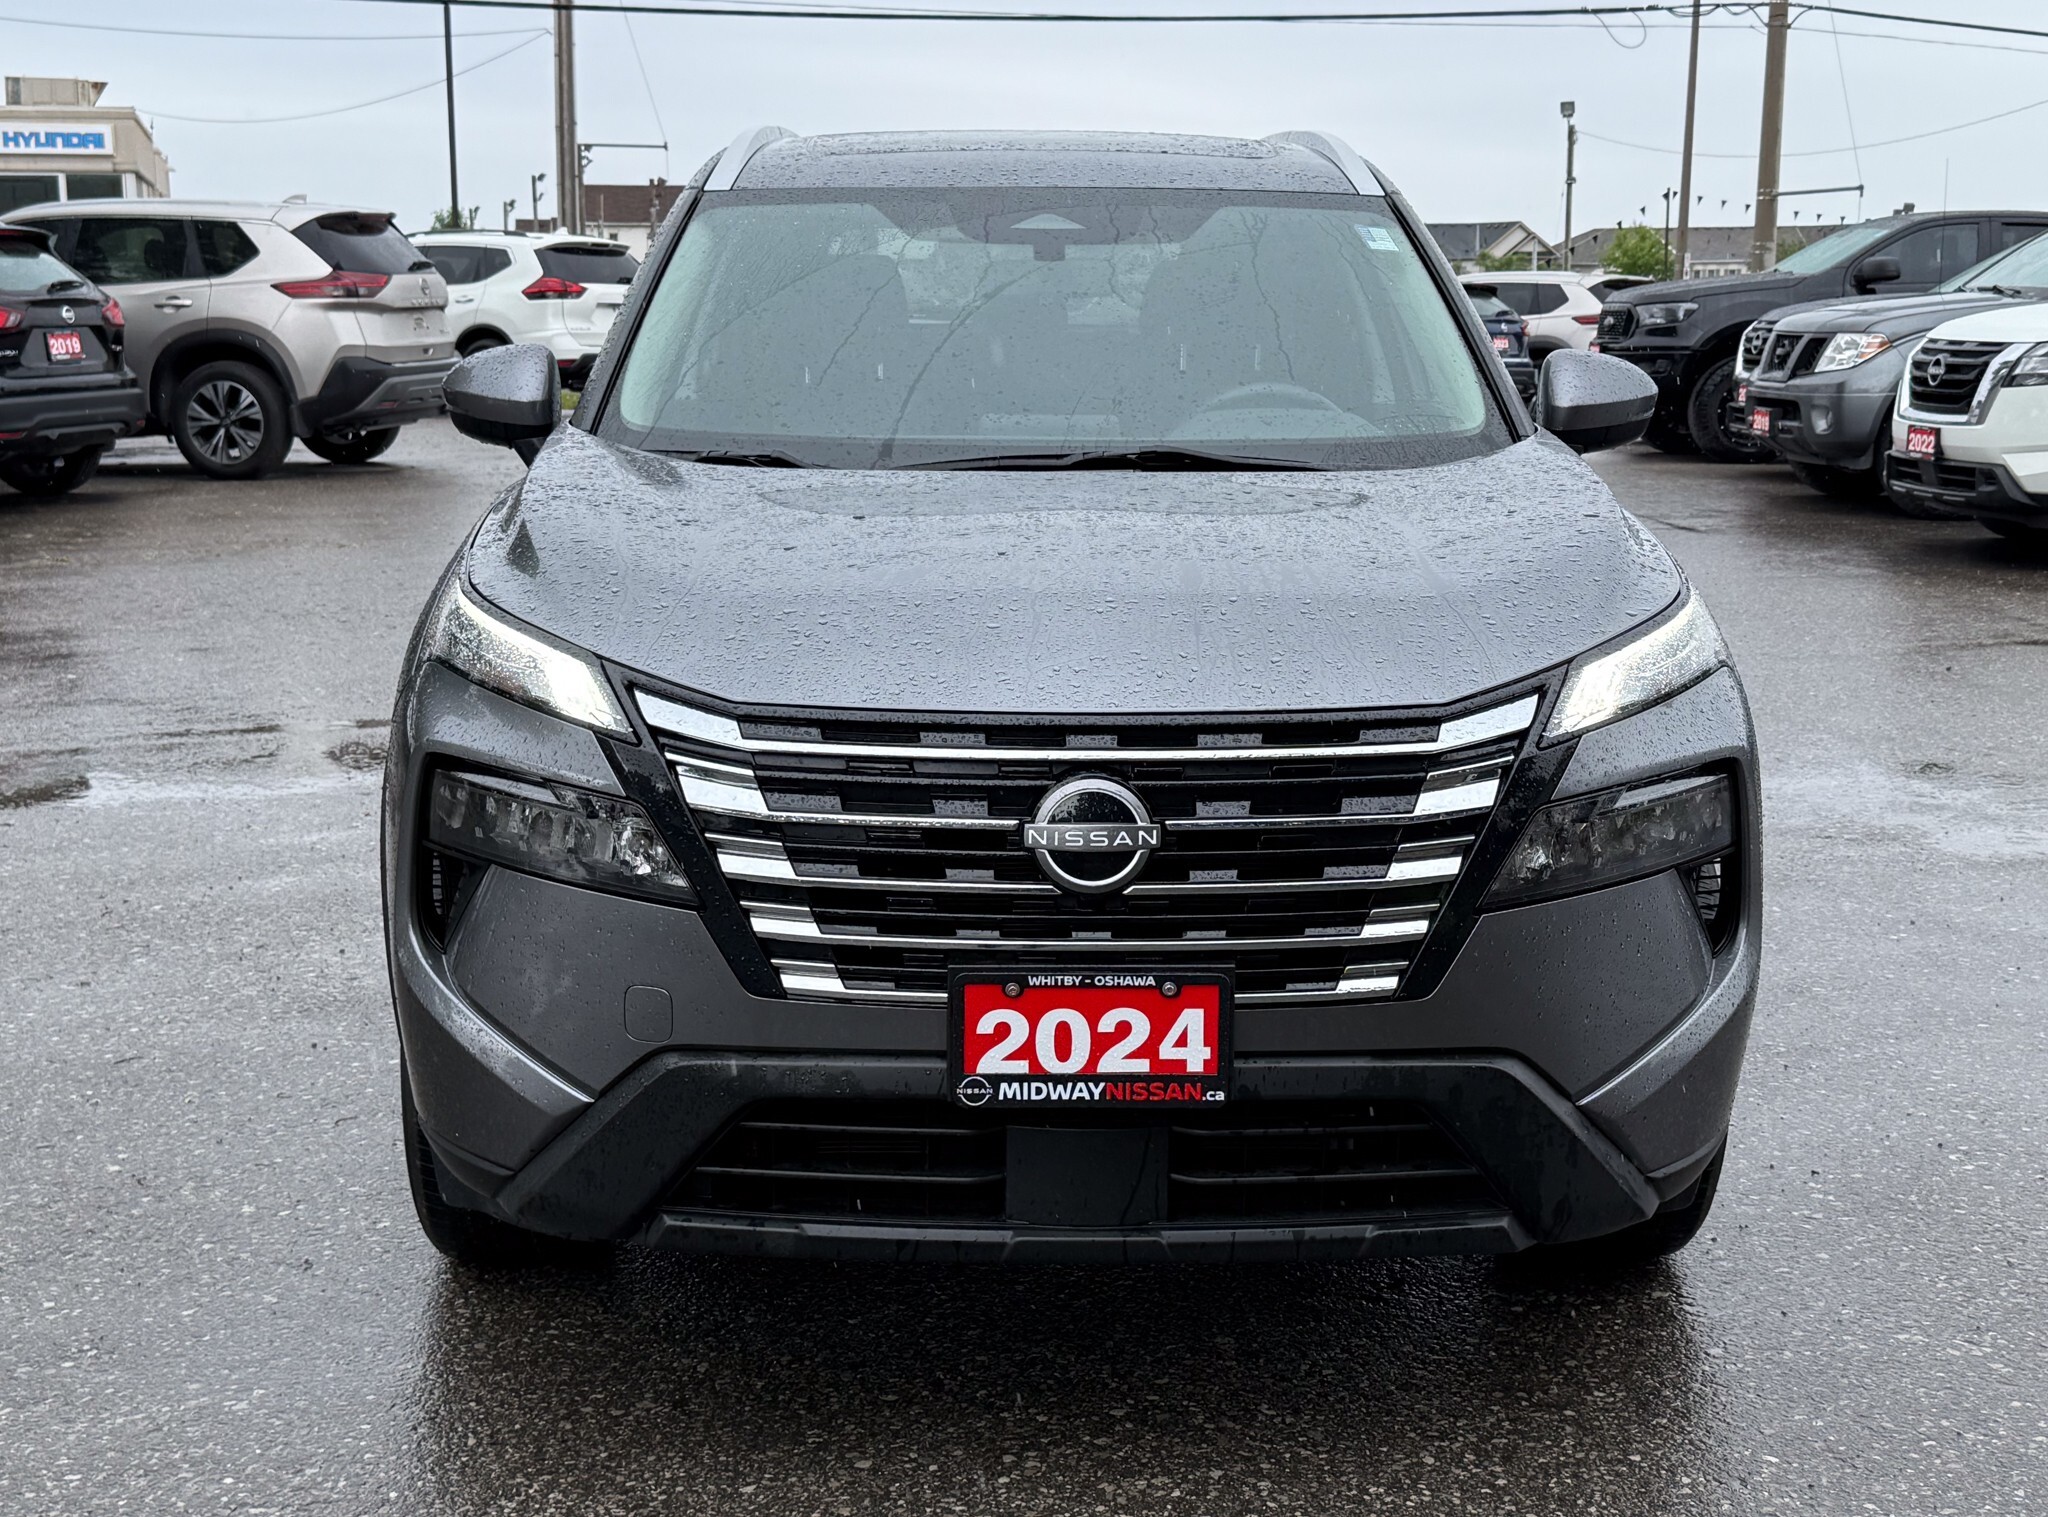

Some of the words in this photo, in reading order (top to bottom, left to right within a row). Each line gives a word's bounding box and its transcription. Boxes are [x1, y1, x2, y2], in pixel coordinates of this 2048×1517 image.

[3, 132, 105, 148] HYUNDAI
[50, 338, 81, 355] 2019
[1908, 433, 1935, 453] 2022
[1028, 829, 1157, 846] NISSAN
[1028, 975, 1082, 986] WHITBY
[1094, 975, 1156, 986] OSHAWA
[975, 1007, 1211, 1074] 2024
